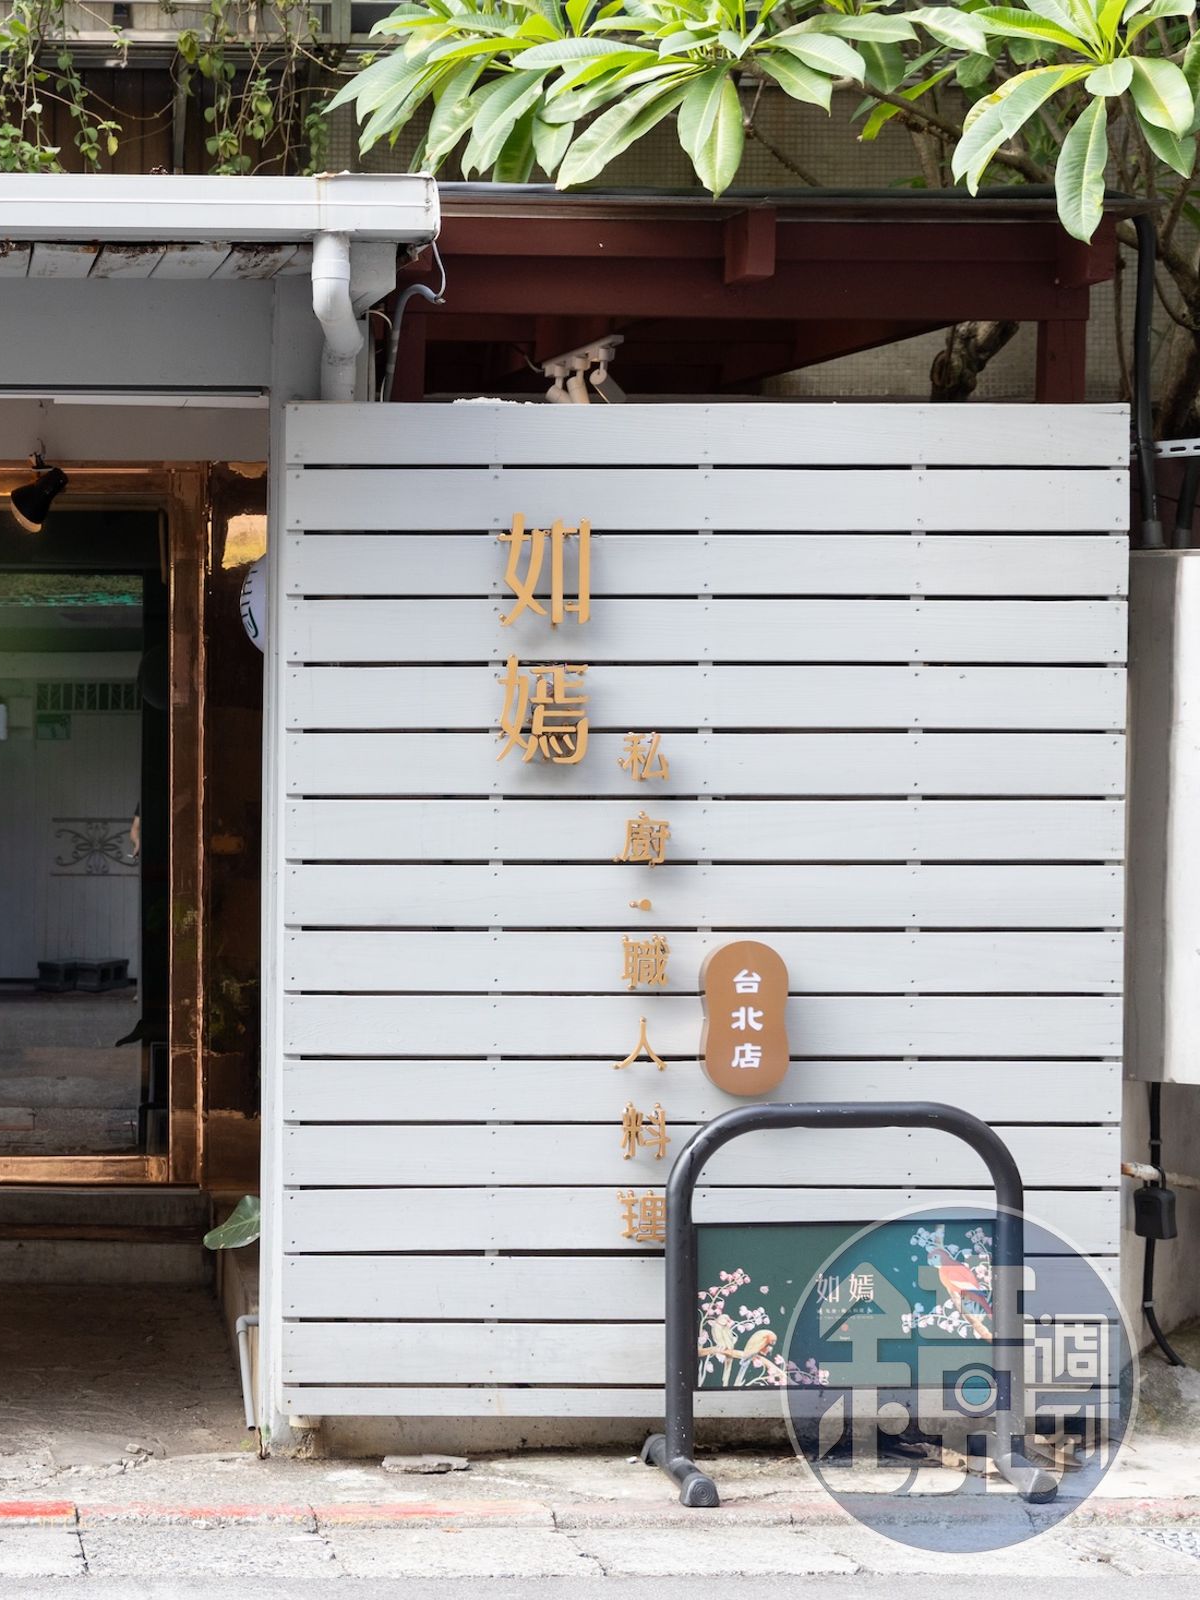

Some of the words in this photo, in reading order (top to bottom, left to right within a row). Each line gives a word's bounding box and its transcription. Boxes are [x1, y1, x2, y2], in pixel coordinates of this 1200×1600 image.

[497, 513, 591, 764] 如嫣
[731, 968, 764, 1070] 台北店
[816, 1273, 875, 1304] 如嫣
